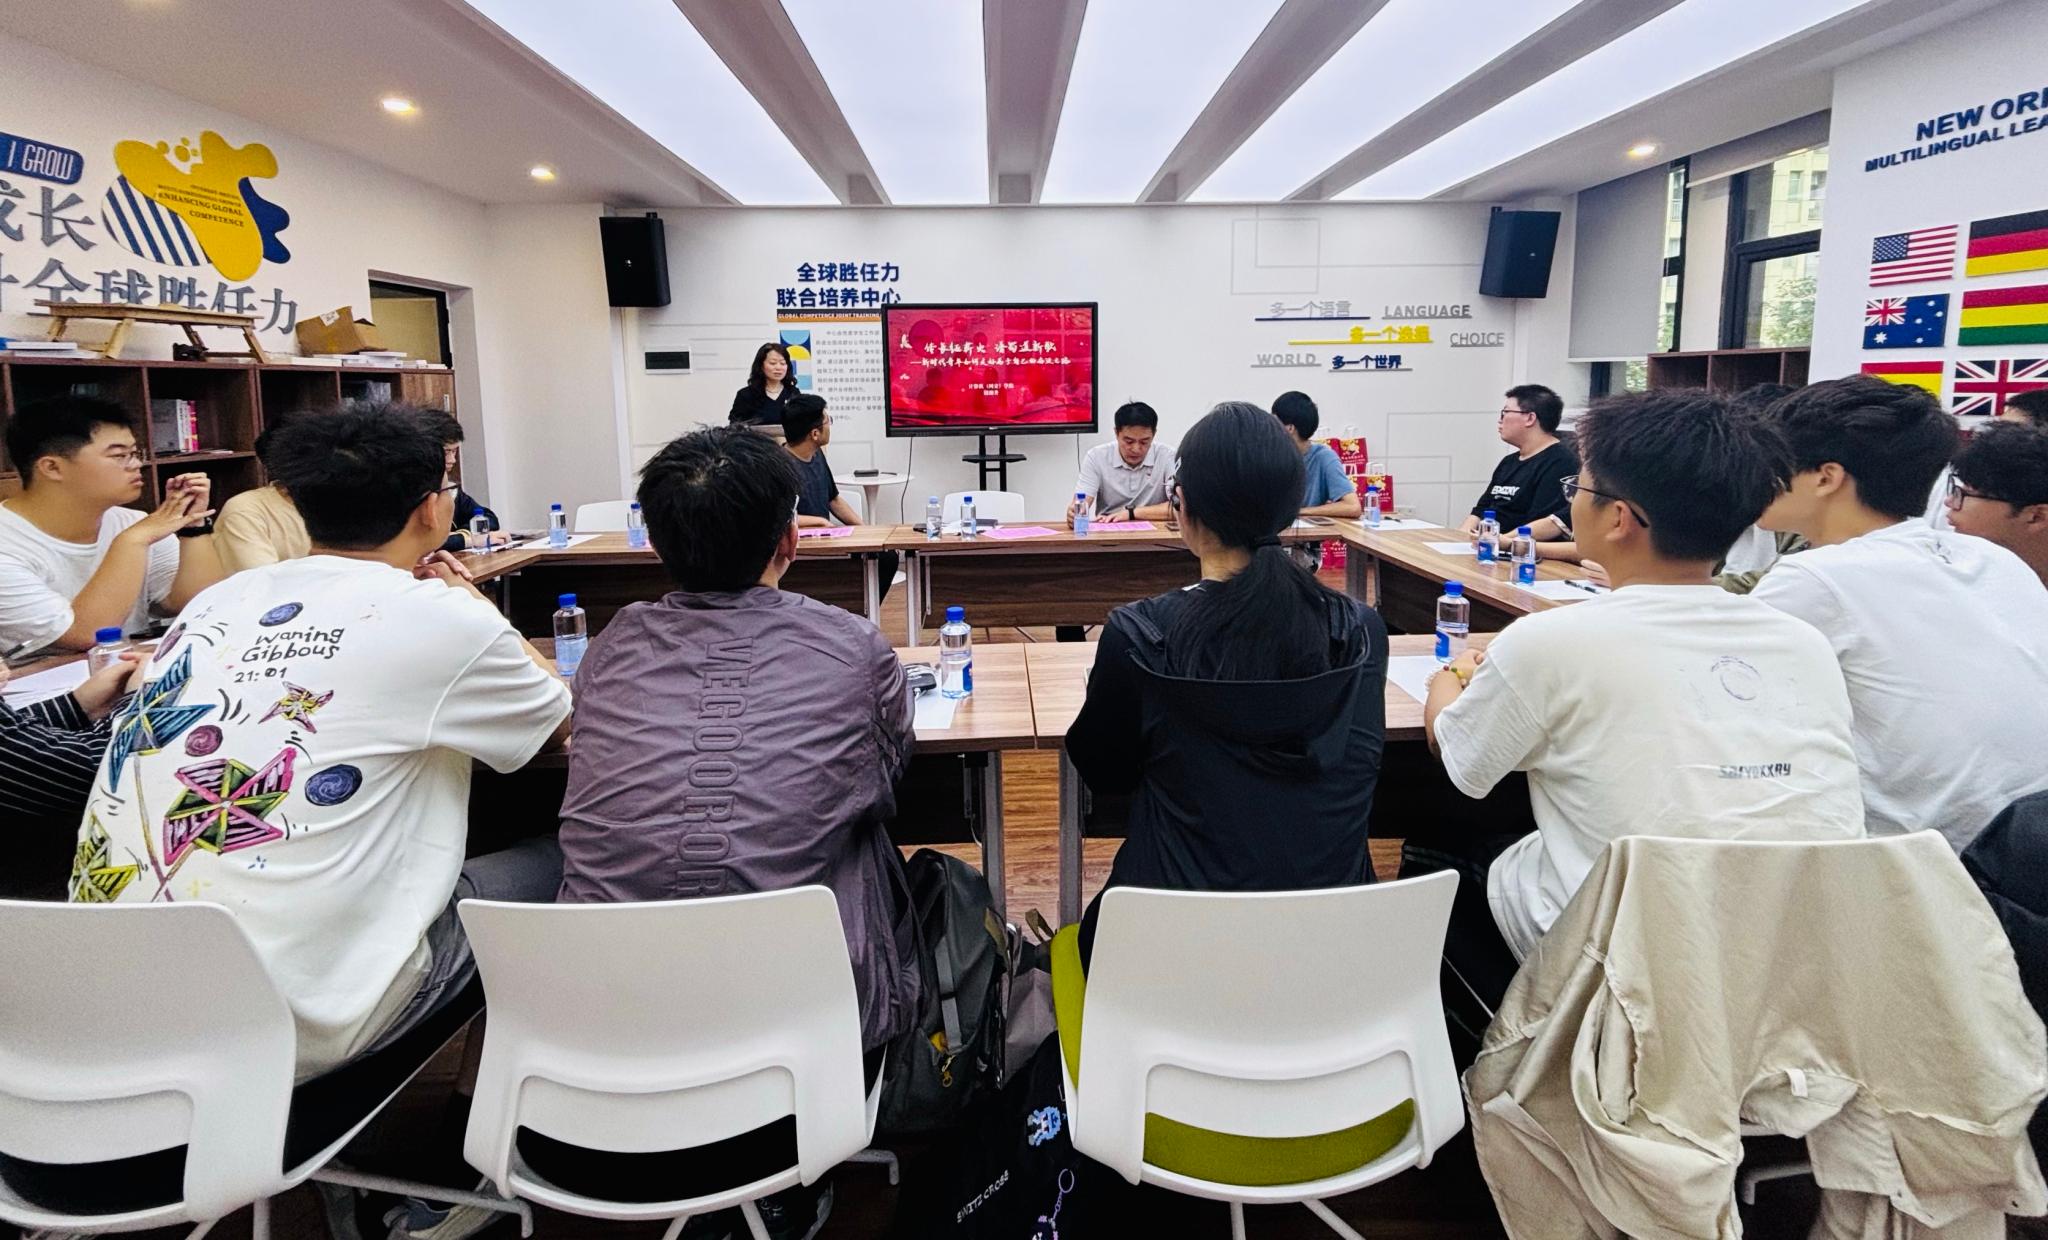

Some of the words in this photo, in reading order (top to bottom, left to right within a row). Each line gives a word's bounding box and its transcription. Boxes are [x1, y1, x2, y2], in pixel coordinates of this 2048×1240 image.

[1916, 105, 1984, 141] NEW
[1865, 127, 2004, 172] MULTILINGUAL
[8, 141, 16, 168] I
[22, 144, 74, 180] GROW
[158, 193, 210, 209] ENHANCING
[212, 203, 243, 216] GLOBAL
[189, 210, 244, 227] COMPETENCE
[797, 262, 900, 282] 全球胜任力
[776, 287, 901, 307] 联合培养中心
[1270, 301, 1351, 317] 多一个语言
[1384, 304, 1471, 318] LANGUAGE
[1450, 332, 1504, 346] CHOICE
[1257, 353, 1316, 366] WORLD
[1332, 355, 1401, 369] 多一个世界
[241, 642, 340, 663] Gibbous
[983, 1169, 1009, 1199] CROSS
